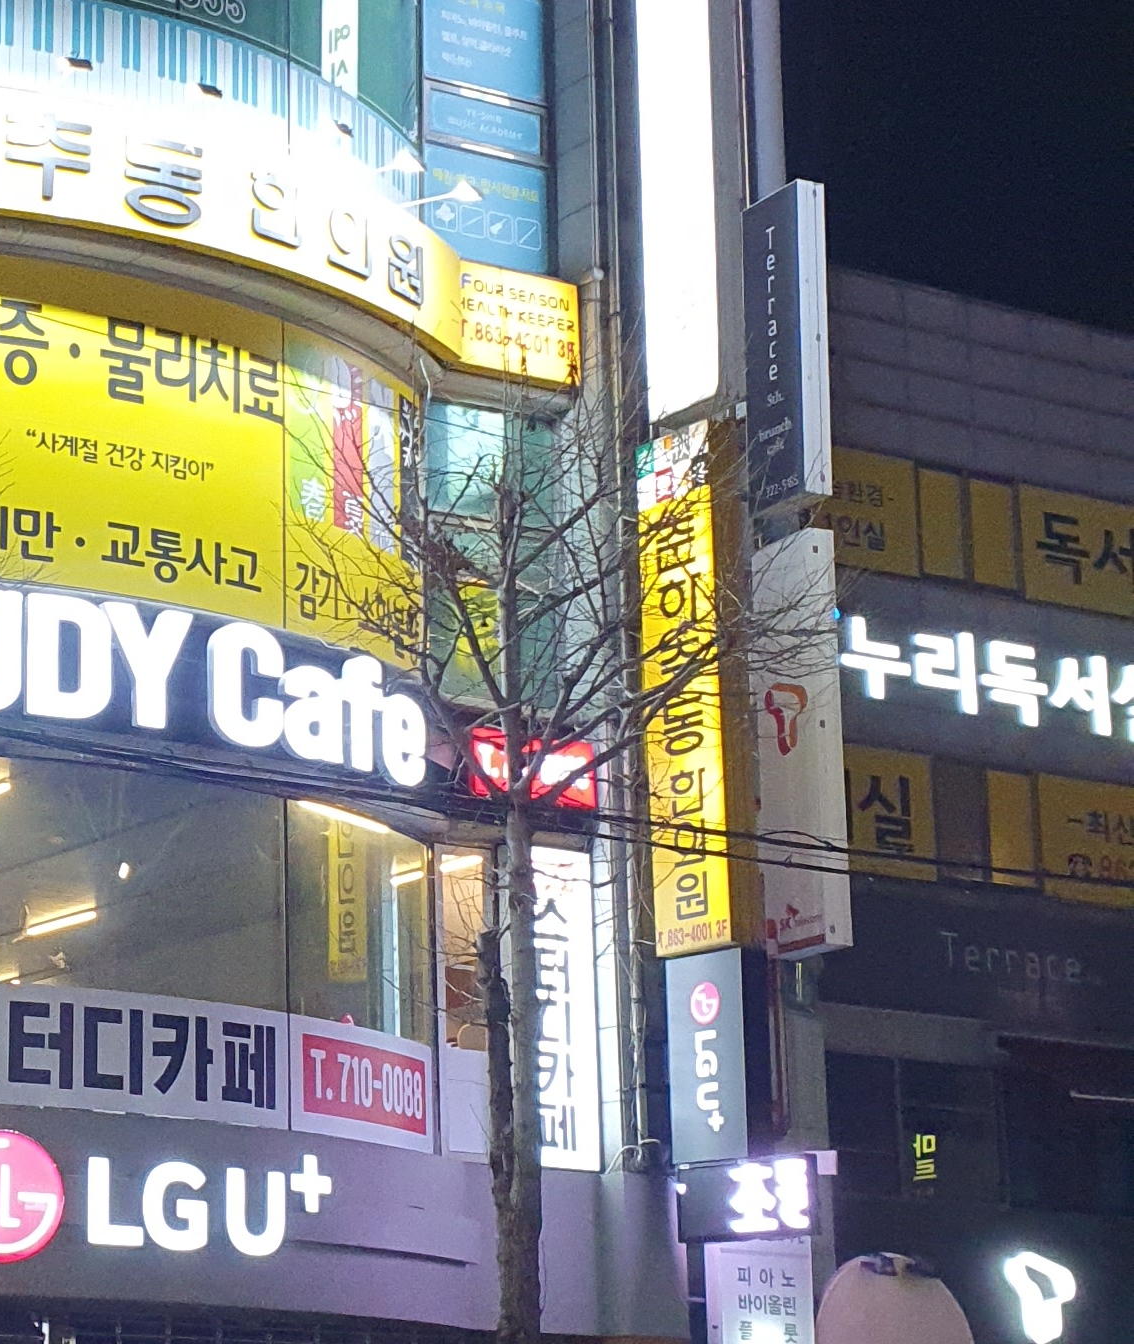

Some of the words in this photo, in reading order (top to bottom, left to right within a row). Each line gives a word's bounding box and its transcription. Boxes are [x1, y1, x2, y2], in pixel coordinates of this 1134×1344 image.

[460, 272, 504, 297] FOUR
[508, 287, 570, 312] SEASON
[765, 225, 779, 381] Terrace
[518, 310, 575, 333] KEEPER
[99, 316, 284, 425] 물리치료
[105, 442, 145, 472] 건강
[100, 520, 262, 594] 교통사고
[206, 620, 427, 787] Cafe
[736, 1265, 797, 1289] 피아노
[737, 1293, 798, 1317] 바이올린
